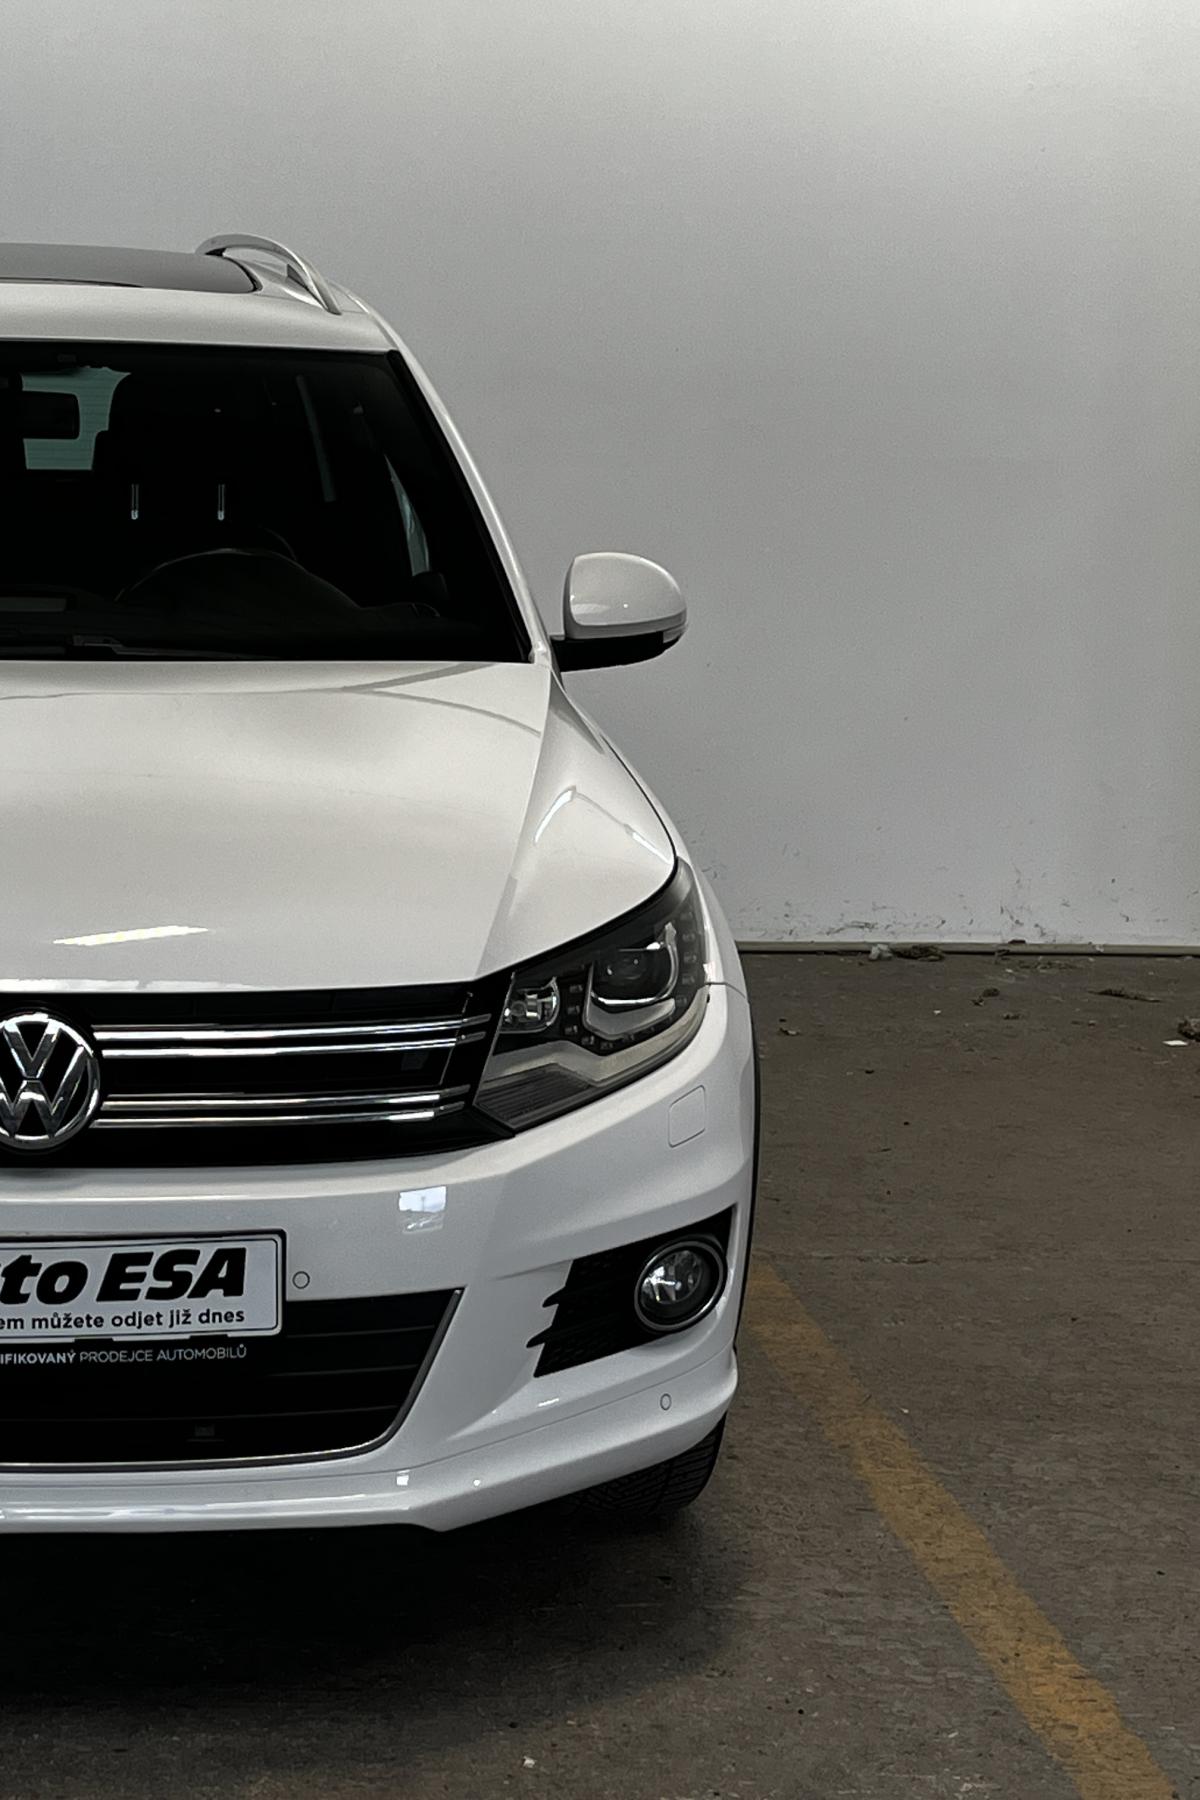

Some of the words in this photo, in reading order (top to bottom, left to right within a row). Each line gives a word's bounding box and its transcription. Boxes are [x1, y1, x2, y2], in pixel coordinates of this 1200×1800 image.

[95, 1247, 247, 1302] ESA
[31, 1312, 105, 1330] můžete
[111, 1311, 164, 1330] odjet
[168, 1308, 192, 1329] již
[198, 1308, 246, 1325] dnes
[79, 1350, 154, 1364] PRODEJCE
[156, 1344, 248, 1362] AUTOMOBILŮ
